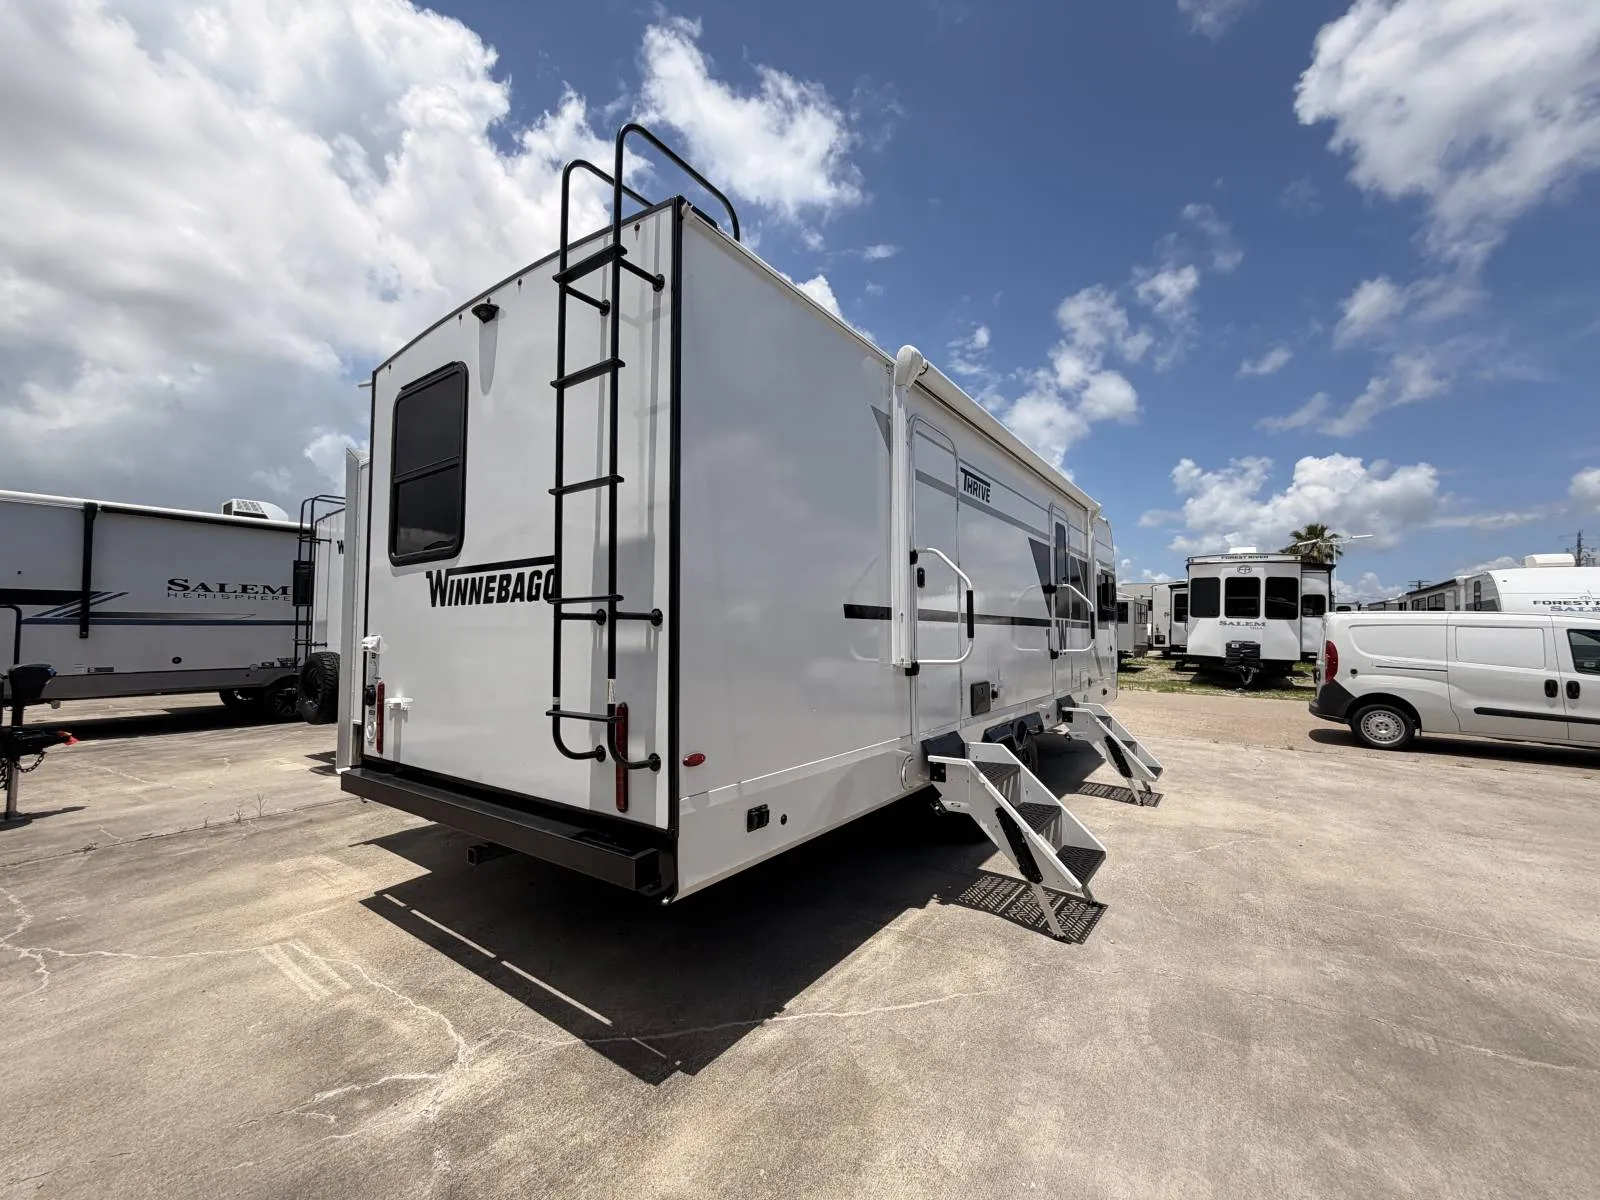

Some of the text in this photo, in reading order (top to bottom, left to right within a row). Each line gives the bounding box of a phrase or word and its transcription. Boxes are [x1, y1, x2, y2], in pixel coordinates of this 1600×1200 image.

[960, 466, 991, 504] THRIVE
[167, 578, 292, 596] SALEM
[167, 592, 292, 602] HEMISPHERE
[426, 567, 557, 608] WINNEBAGO
